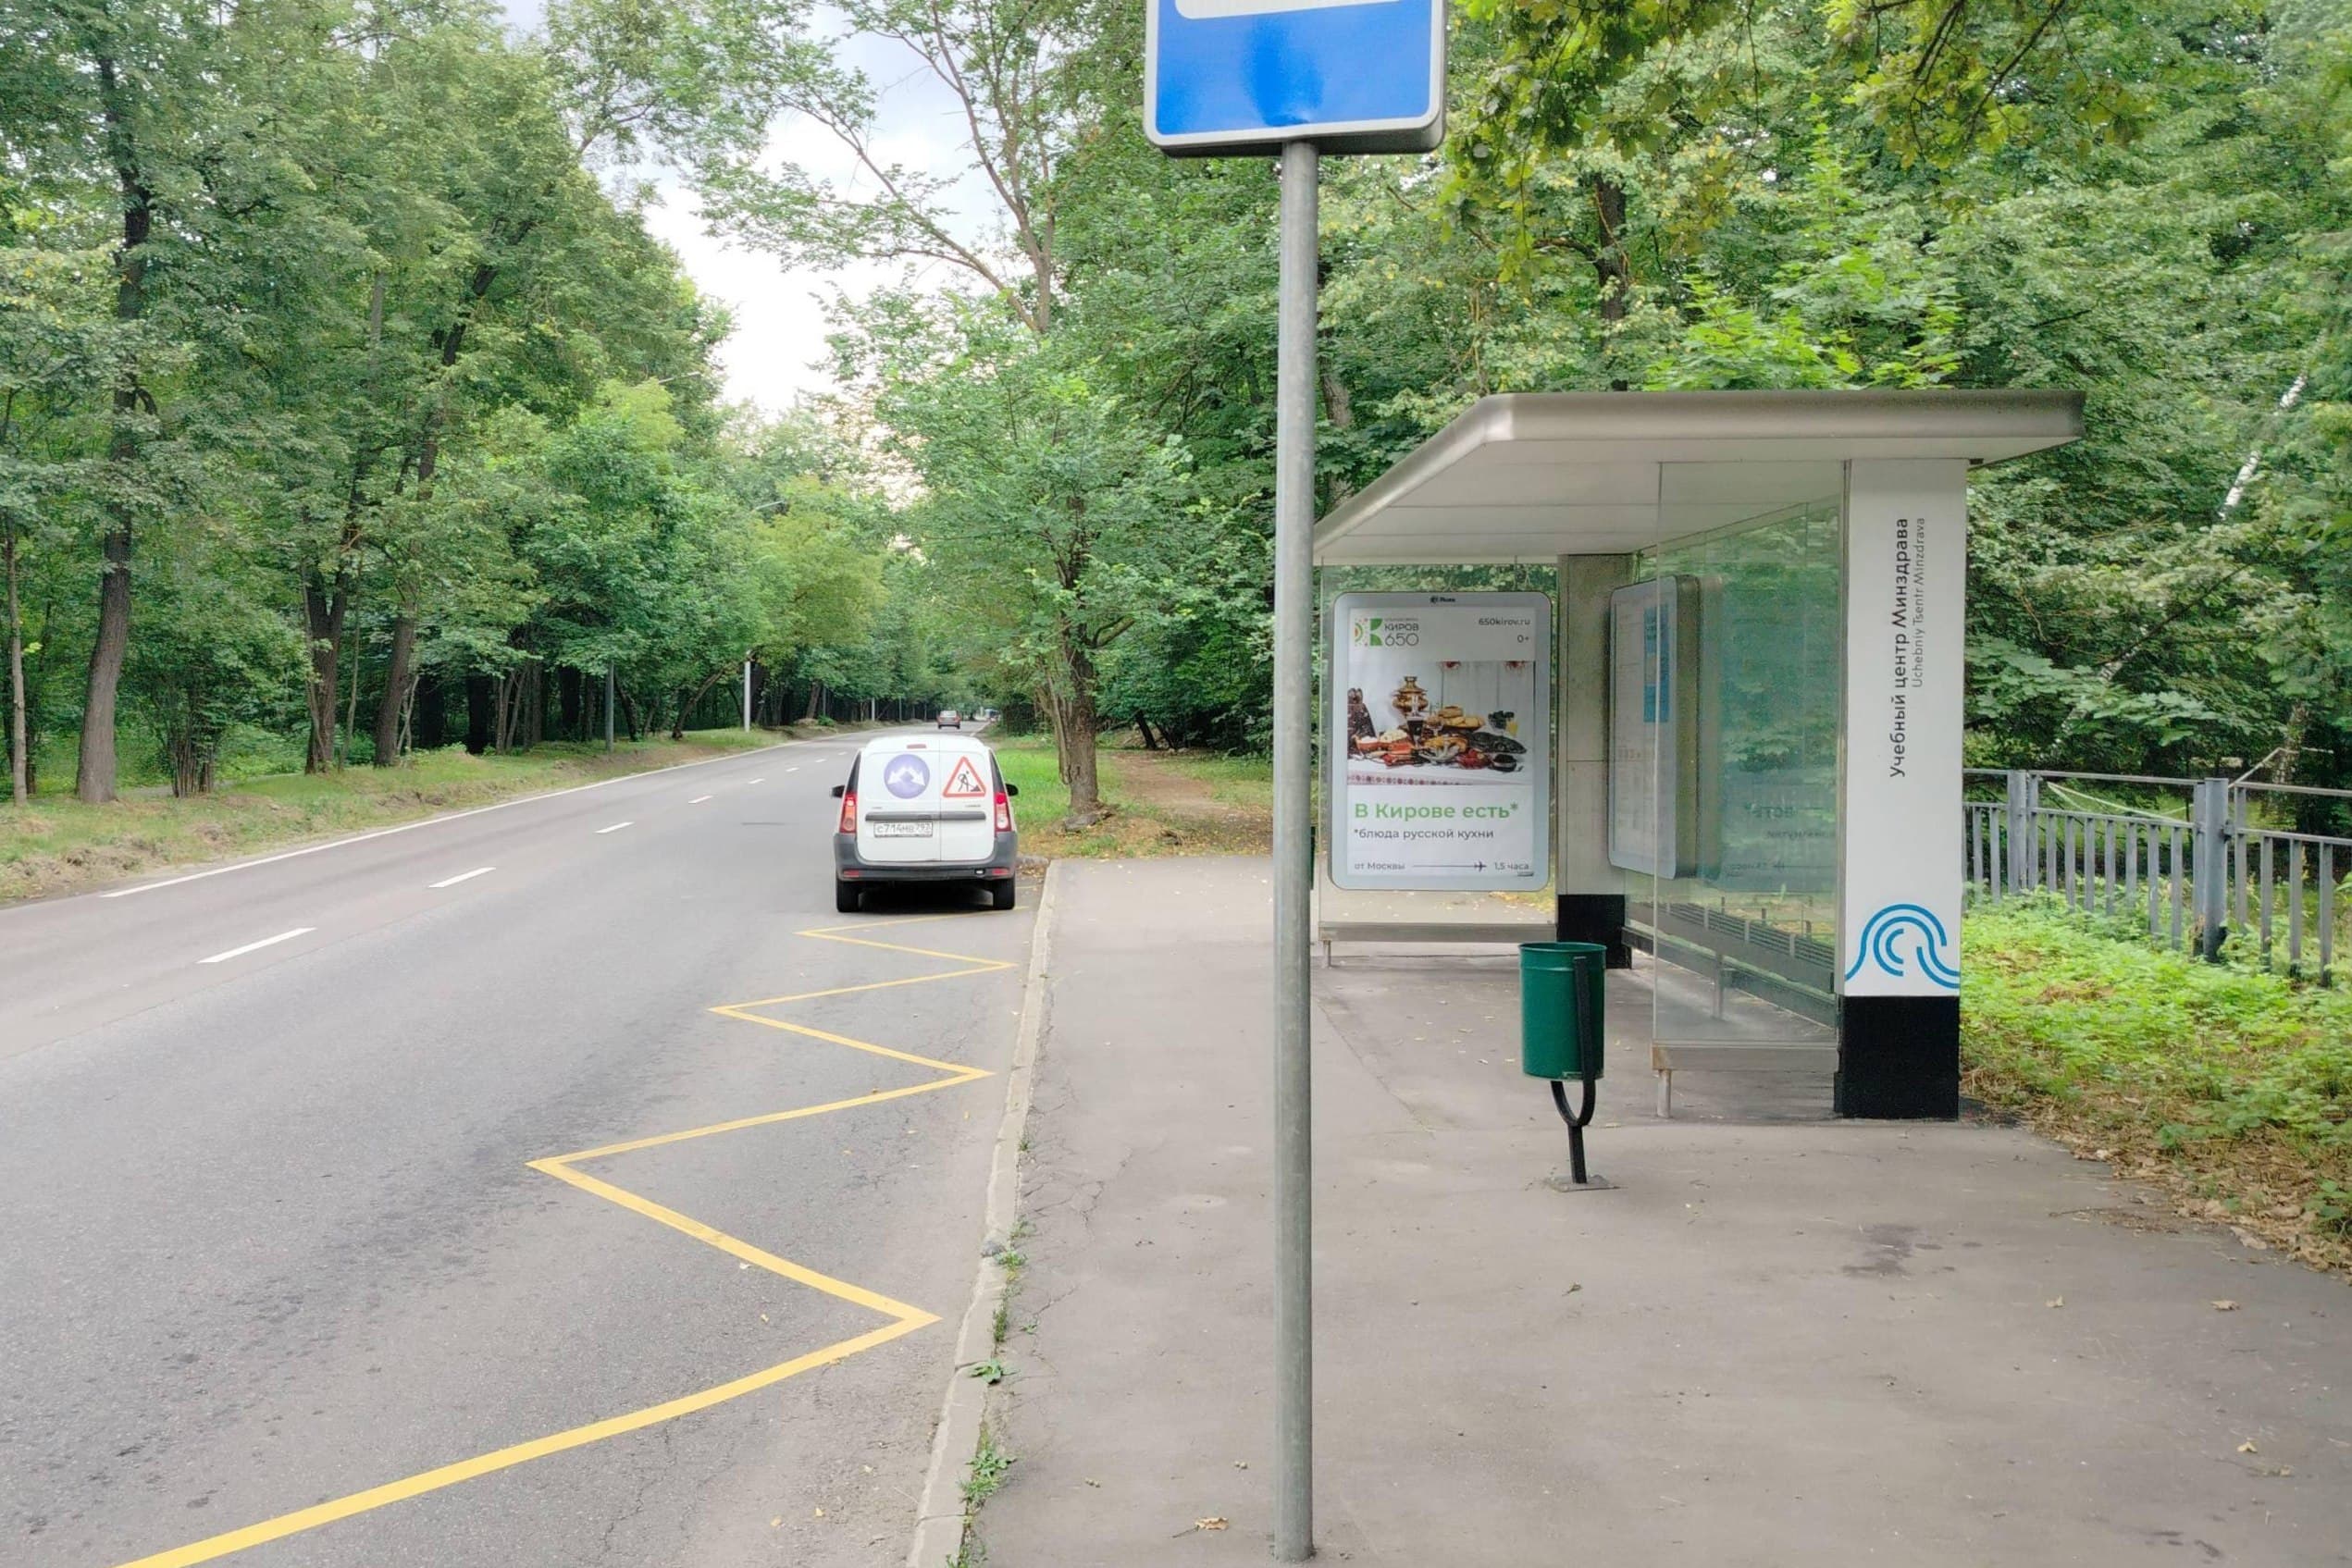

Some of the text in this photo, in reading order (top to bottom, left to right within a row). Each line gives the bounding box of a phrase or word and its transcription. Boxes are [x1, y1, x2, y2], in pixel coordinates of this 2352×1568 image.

[1912, 517, 1925, 688] Uchebniy Tsentr Minzdrava
[1384, 623, 1419, 632] КИРОВ
[1478, 616, 1531, 626] 650kirov.ru
[1384, 632, 1419, 648] 650
[1889, 518, 1911, 778] Учебный центр Минздрава
[1355, 803, 1368, 819] В
[1376, 803, 1456, 821] Кирове
[1403, 828, 1455, 841] русской
[1457, 830, 1495, 841] кухни
[1368, 862, 1405, 870] Москвы
